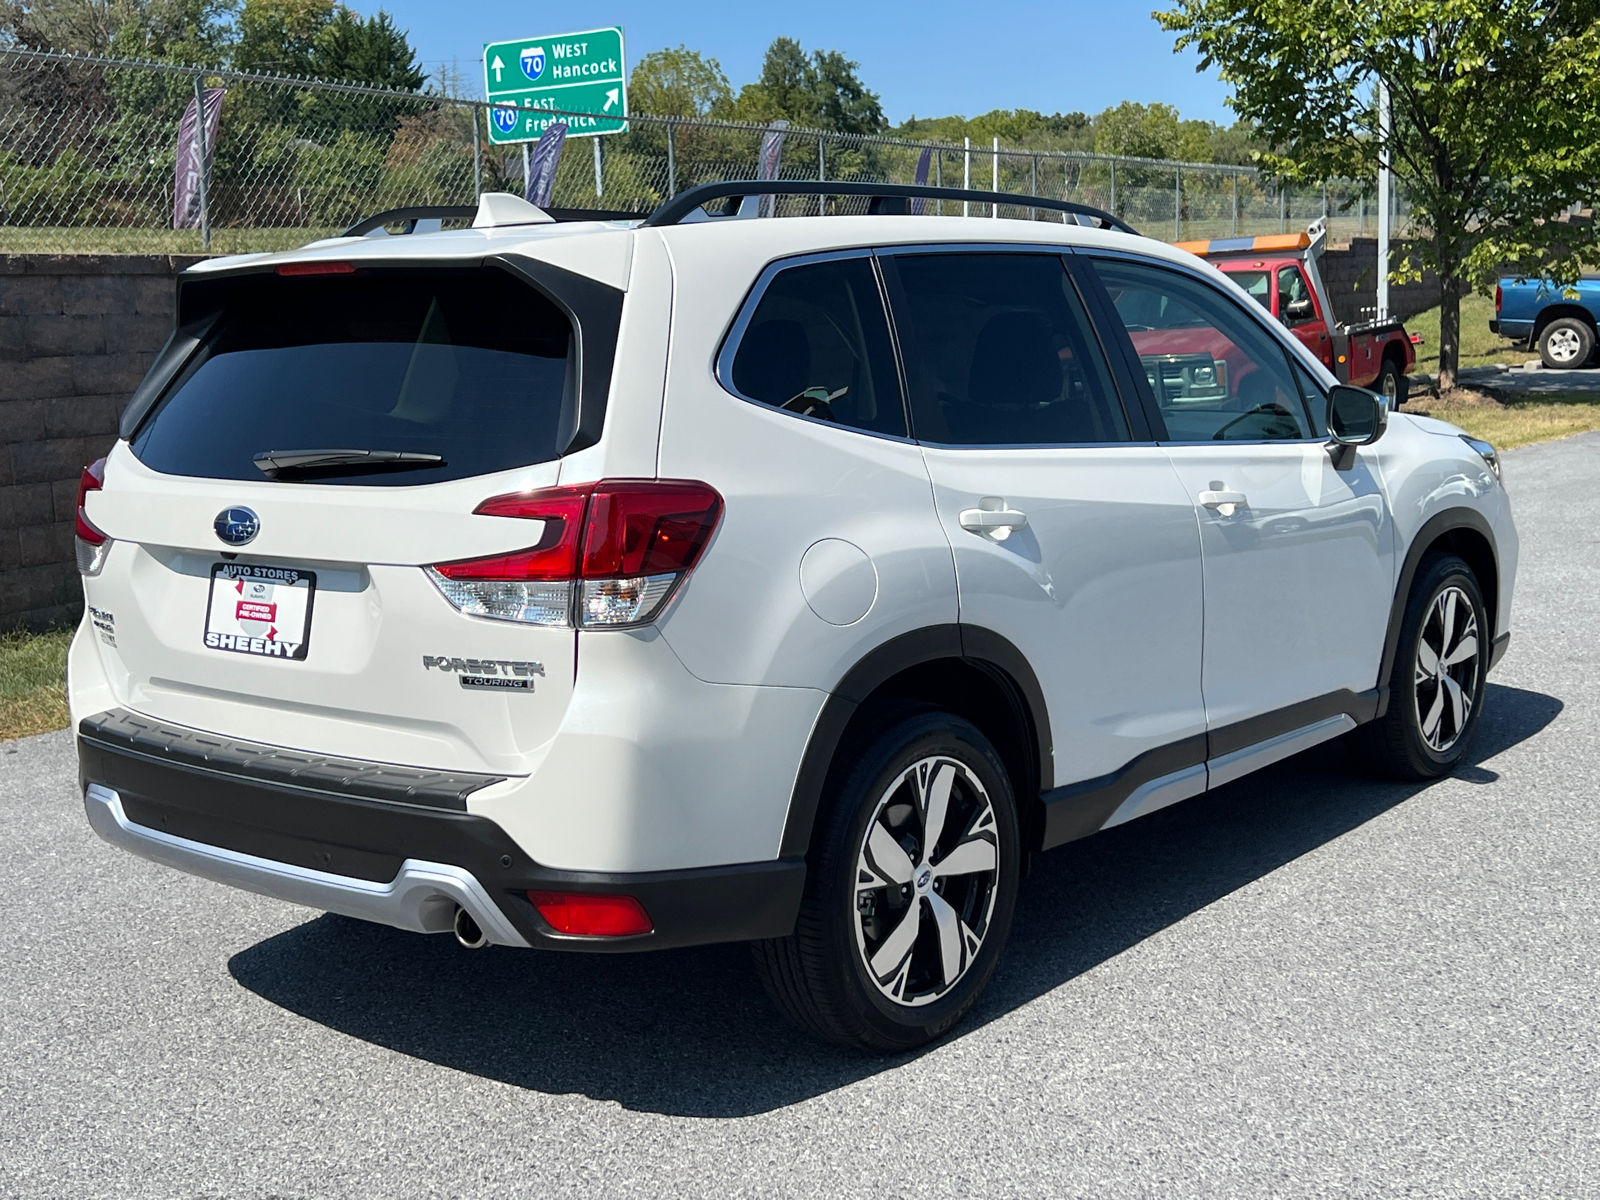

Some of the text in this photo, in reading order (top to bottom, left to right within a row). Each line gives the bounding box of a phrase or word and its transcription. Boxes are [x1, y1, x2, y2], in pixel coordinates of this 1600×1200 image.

[552, 43, 588, 59] WEST
[524, 57, 543, 74] 70
[553, 58, 617, 79] Hancock
[524, 98, 555, 110] EAST
[496, 109, 515, 126] 70
[222, 565, 299, 581] AUTO STORES
[239, 610, 272, 620] PRE-OWNED
[242, 604, 270, 613] CERTIFIED
[206, 632, 300, 658] SHEEHY
[423, 655, 545, 677] FORESTER
[466, 677, 523, 688] TOURING
